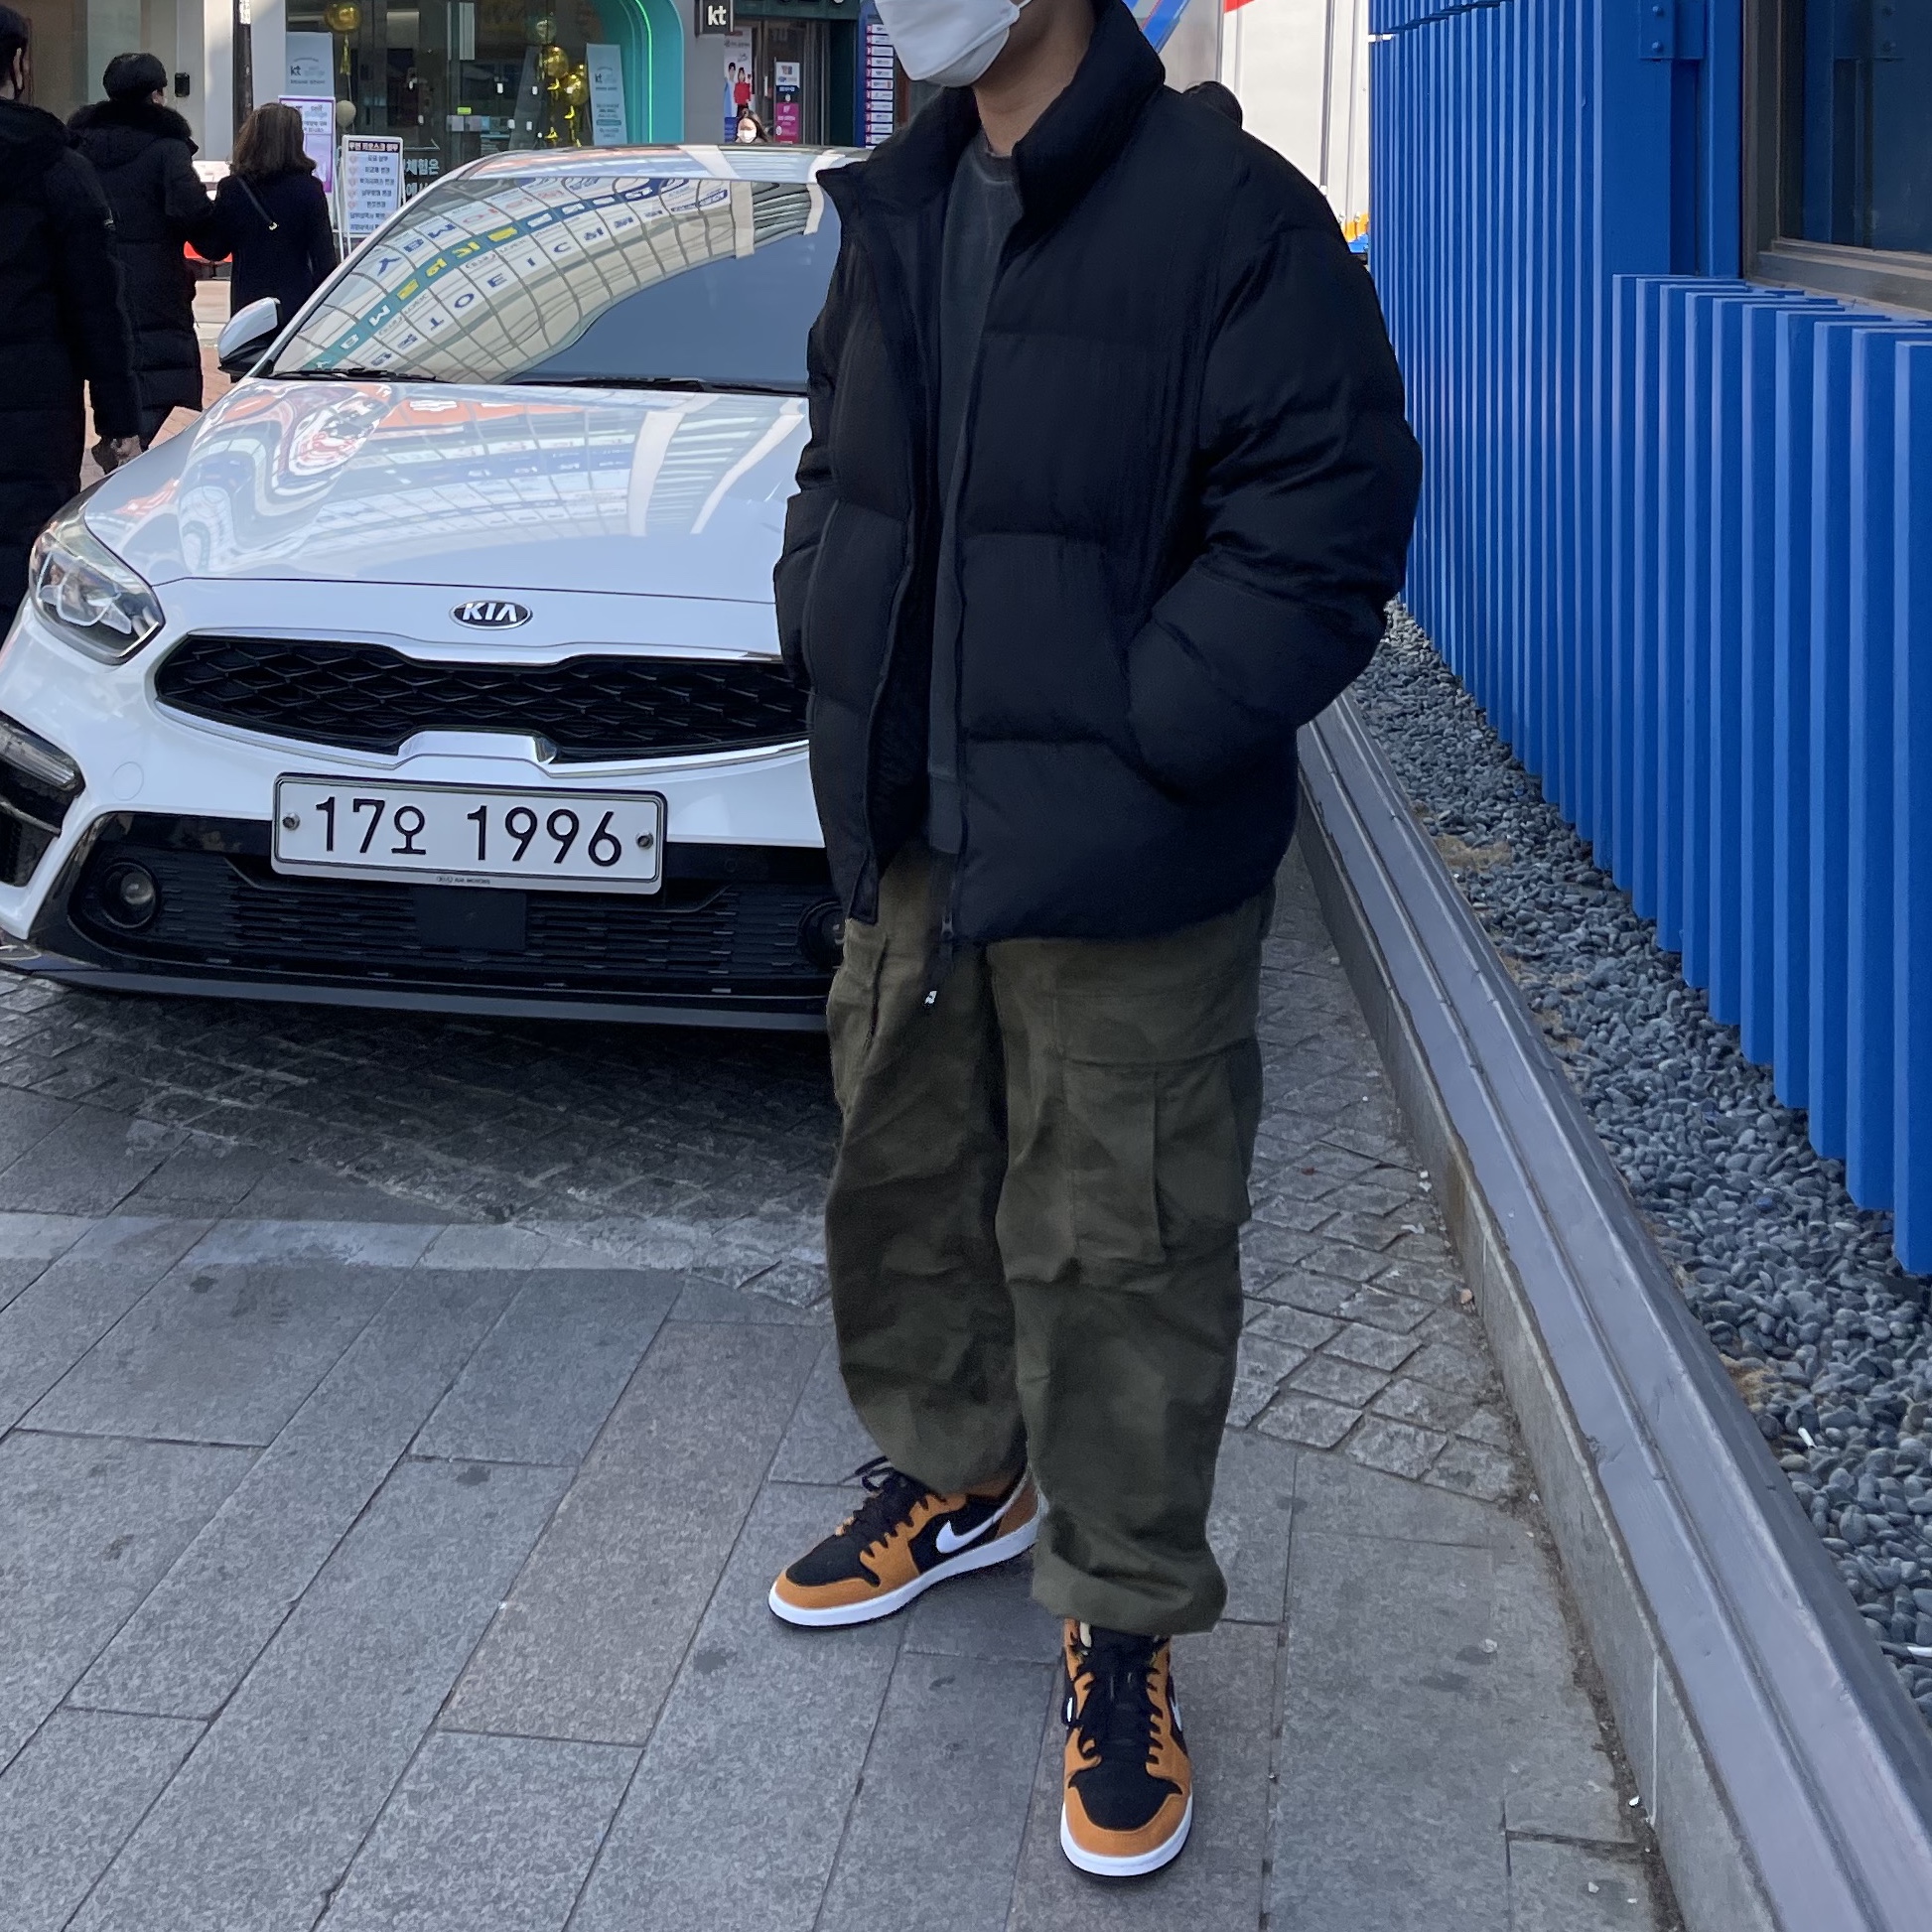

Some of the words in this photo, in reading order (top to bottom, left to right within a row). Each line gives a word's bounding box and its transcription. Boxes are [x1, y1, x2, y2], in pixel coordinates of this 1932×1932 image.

[708, 5, 727, 26] kt
[403, 159, 440, 176] 체험은
[462, 602, 517, 622] KIA
[316, 796, 427, 855] 17오
[467, 805, 622, 867] 1996
